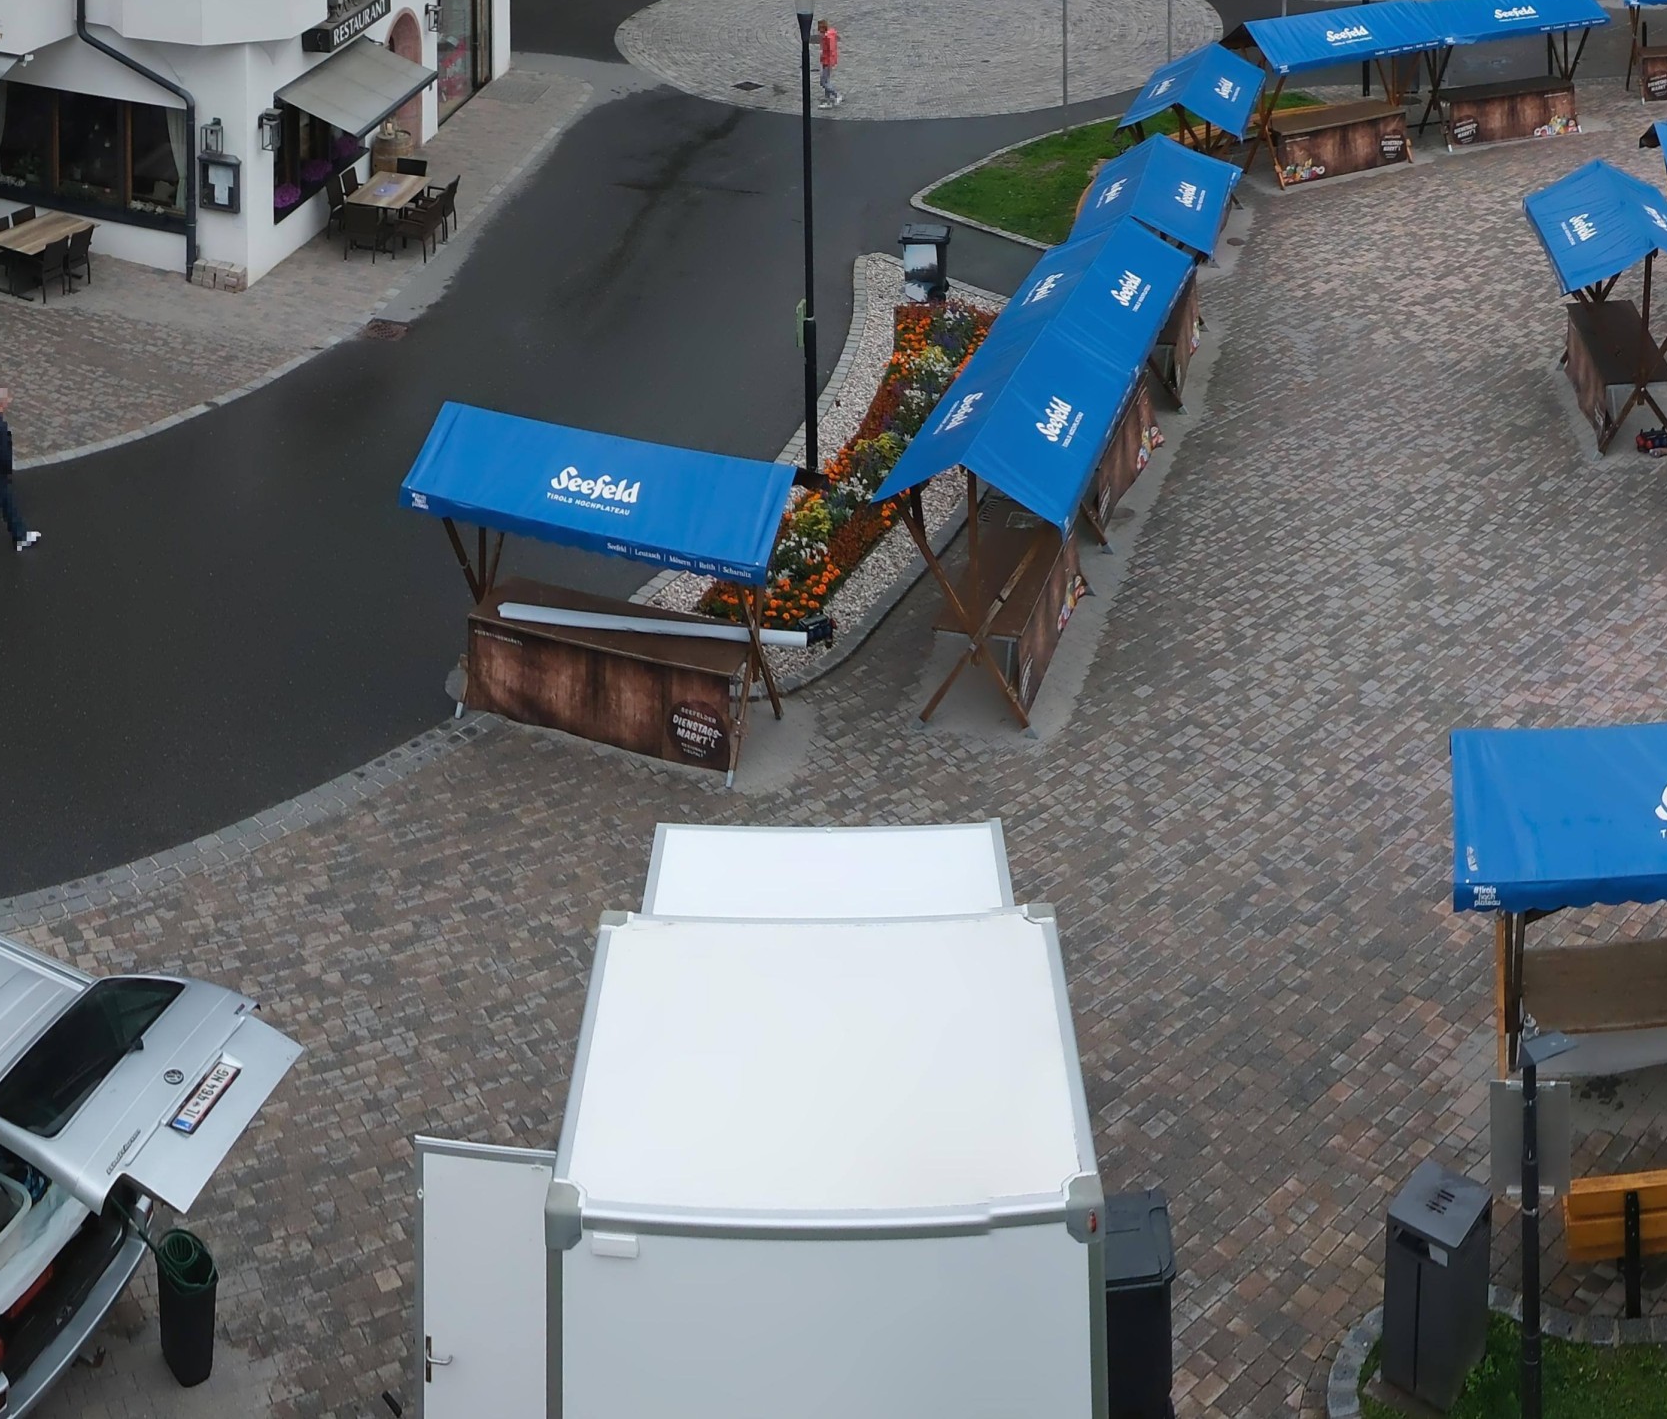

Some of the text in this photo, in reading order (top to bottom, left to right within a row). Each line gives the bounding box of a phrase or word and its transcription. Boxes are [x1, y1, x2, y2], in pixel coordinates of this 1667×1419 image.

[1494, 5, 1537, 19] Seefeld
[1326, 24, 1370, 42] Seefeld
[1568, 212, 1599, 243] Seefeld
[1110, 270, 1142, 307] Seefeld
[1035, 395, 1073, 442] Seefeld
[551, 465, 641, 504] Seefeld
[546, 491, 631, 516] TIROLS HOCHPLATEAU
